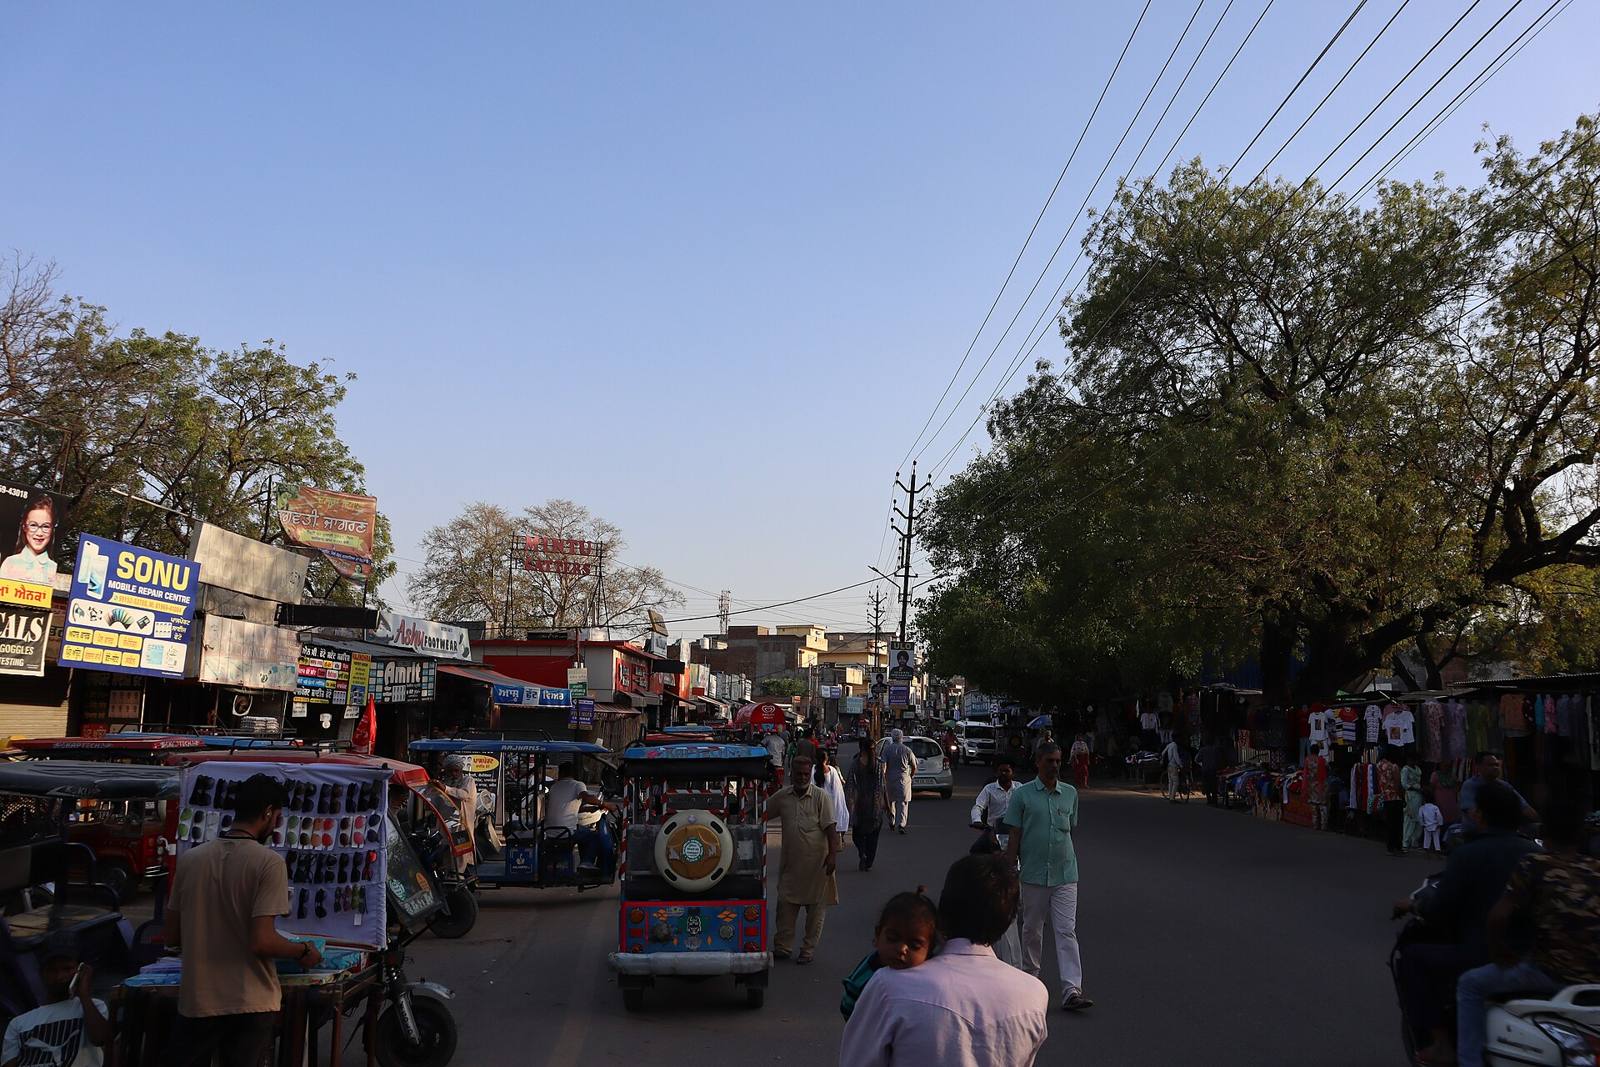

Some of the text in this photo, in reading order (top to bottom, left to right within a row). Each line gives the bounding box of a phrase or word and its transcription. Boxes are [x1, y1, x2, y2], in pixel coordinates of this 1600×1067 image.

[116, 551, 190, 591] SONU
[108, 580, 136, 593] MOBILE
[138, 586, 163, 598] REPAIR
[164, 592, 191, 604] CENTRE
[0, 643, 34, 655] GOGGLES
[425, 636, 458, 652] FOOTWEAR
[0, 656, 24, 667] ESTING
[384, 661, 422, 686] Amrit
